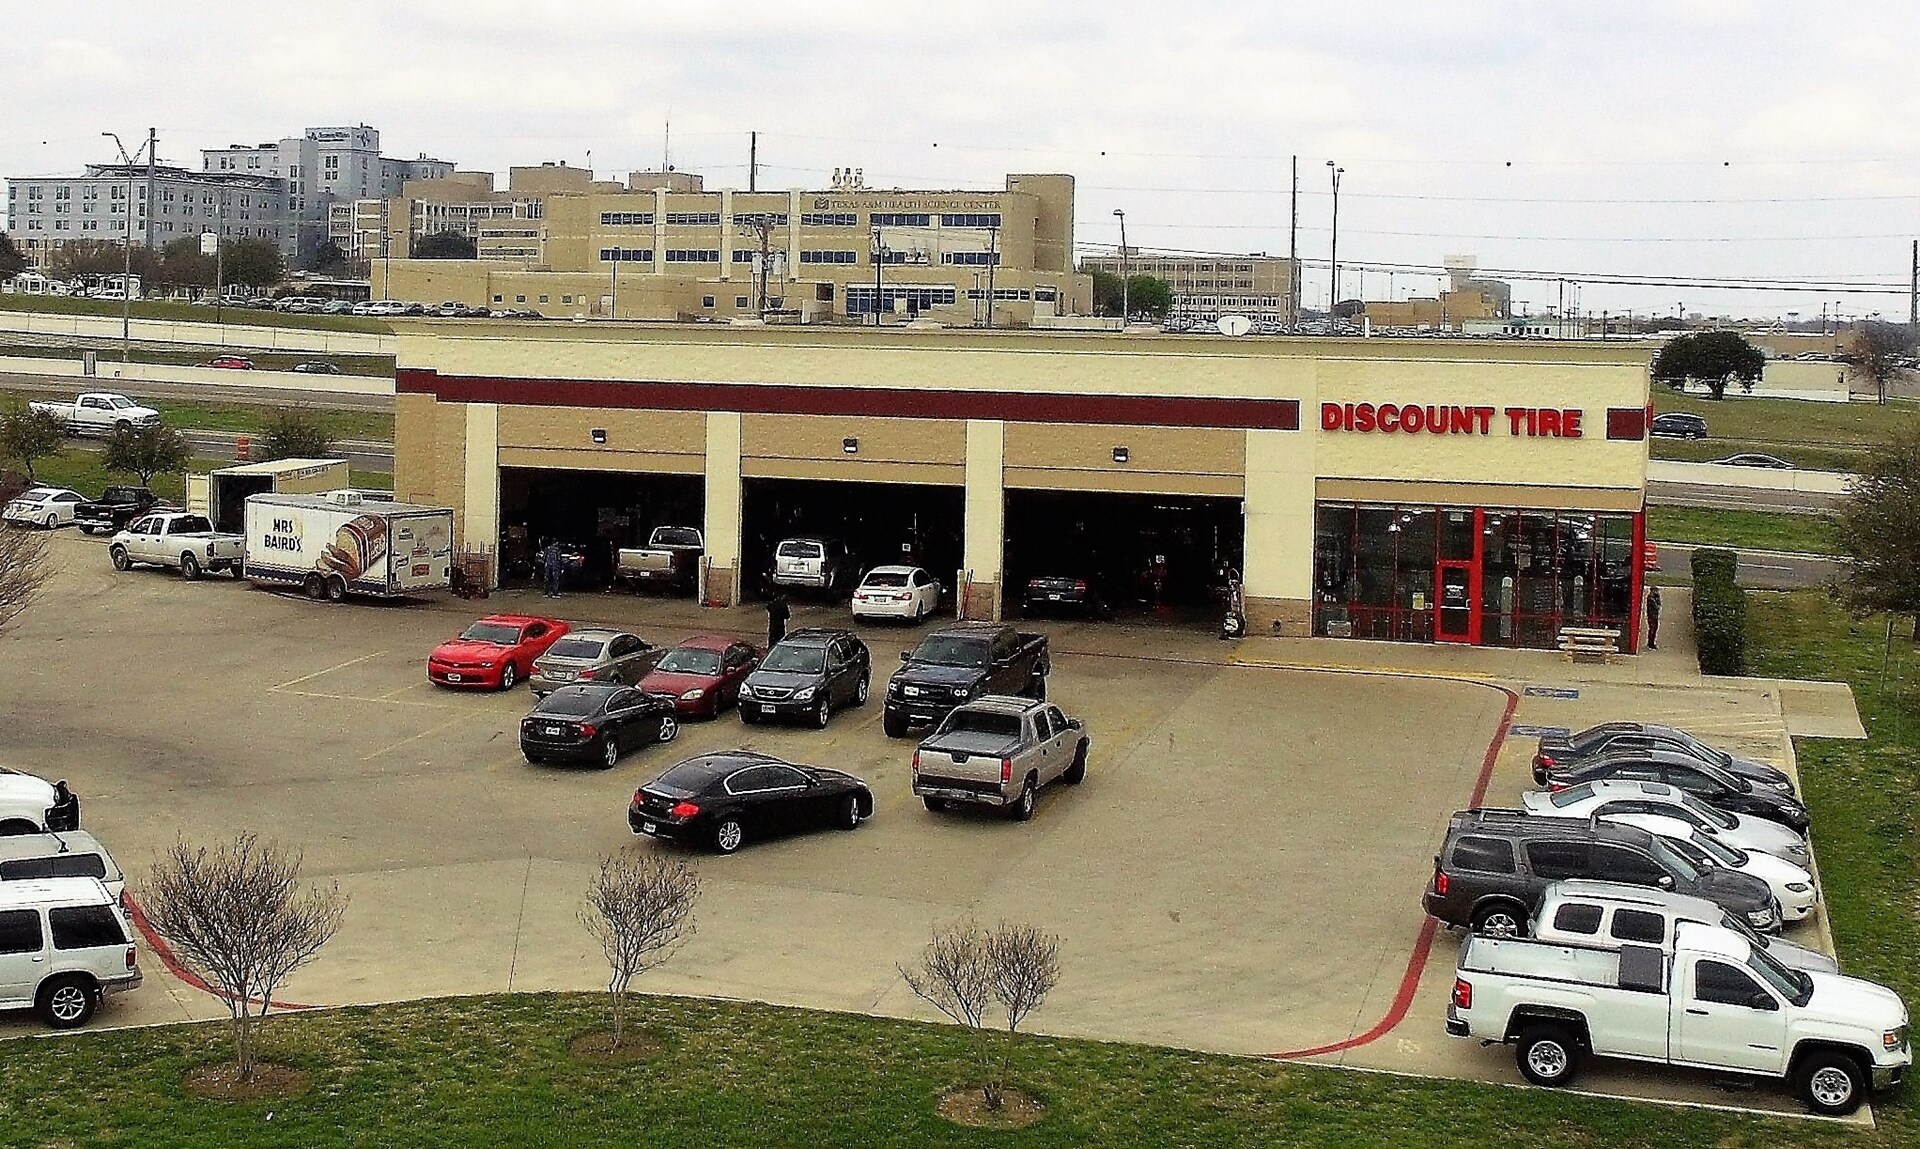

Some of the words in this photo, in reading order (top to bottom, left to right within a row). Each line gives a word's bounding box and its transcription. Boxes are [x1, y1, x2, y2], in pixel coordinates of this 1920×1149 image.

[884, 200, 921, 209] HEALTH
[922, 200, 960, 209] SCIENCE
[963, 200, 1001, 209] CENTER
[1321, 402, 1495, 434] DISCOUNT
[1504, 407, 1583, 437] TIRE
[273, 518, 293, 533] MRS
[264, 534, 302, 552] BAIRD'S
